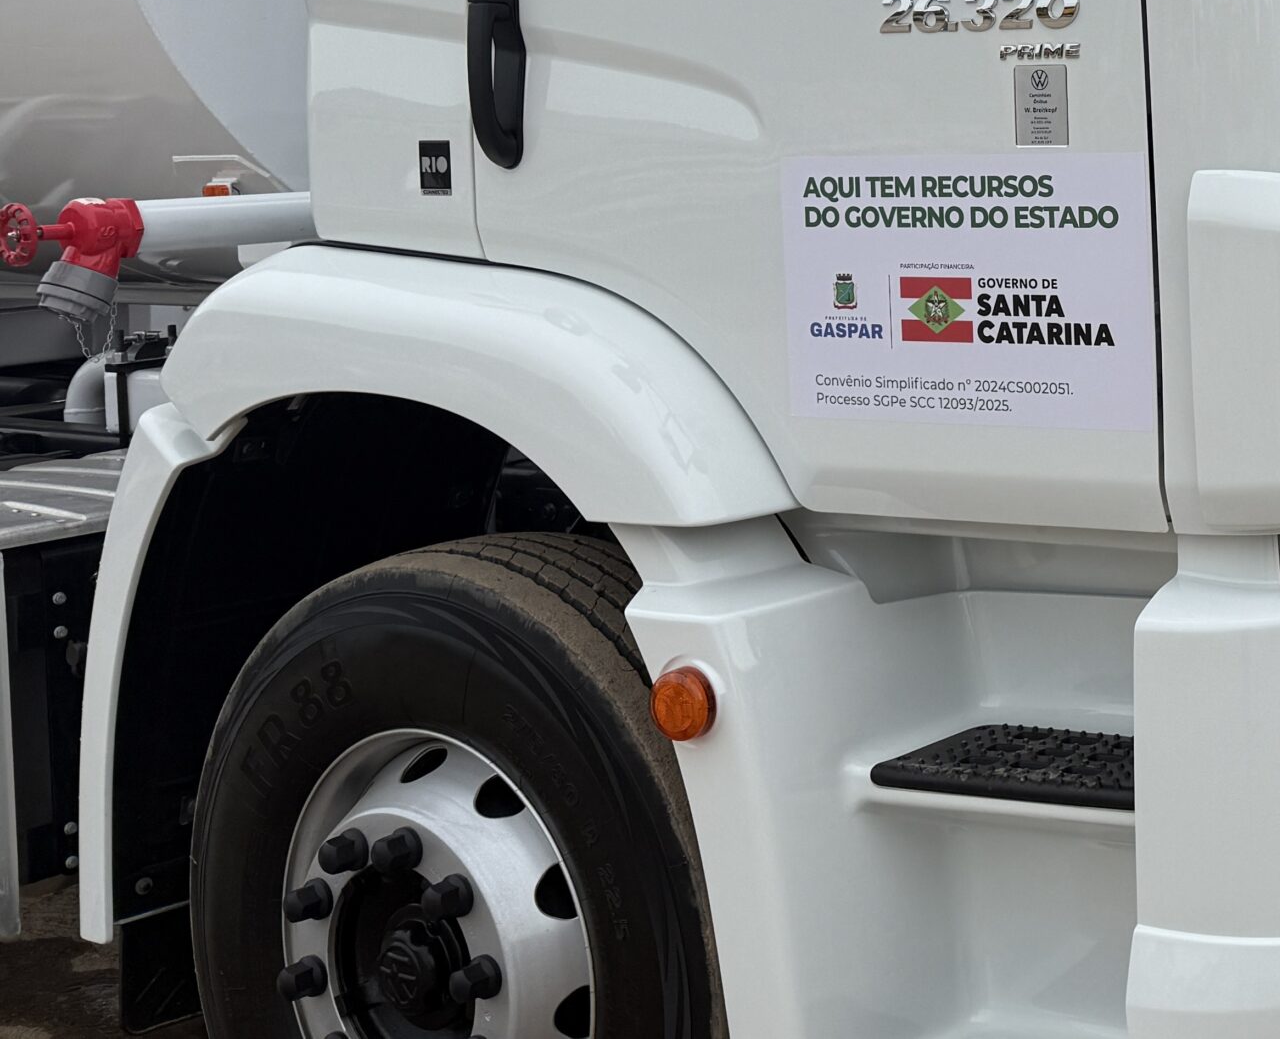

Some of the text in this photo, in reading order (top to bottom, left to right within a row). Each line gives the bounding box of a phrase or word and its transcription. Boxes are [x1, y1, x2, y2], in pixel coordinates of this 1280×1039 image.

[1000, 43, 1081, 61] PRIME
[421, 156, 448, 173] RIO
[803, 175, 1054, 202] AQUI TEM RECURSOS
[804, 206, 1119, 228] DO GOVERNO DO ESTADO
[978, 278, 1058, 289] GOVERNO DE
[977, 293, 1065, 317] SANTA
[810, 322, 883, 339] GASPAR
[977, 320, 1115, 346] CATARINA
[815, 374, 872, 388] Convênio
[875, 376, 954, 391] Simplificado
[974, 380, 1074, 395] 2024CS002051.
[816, 392, 1012, 412] Processo SGPe SCC 12093/2025.
